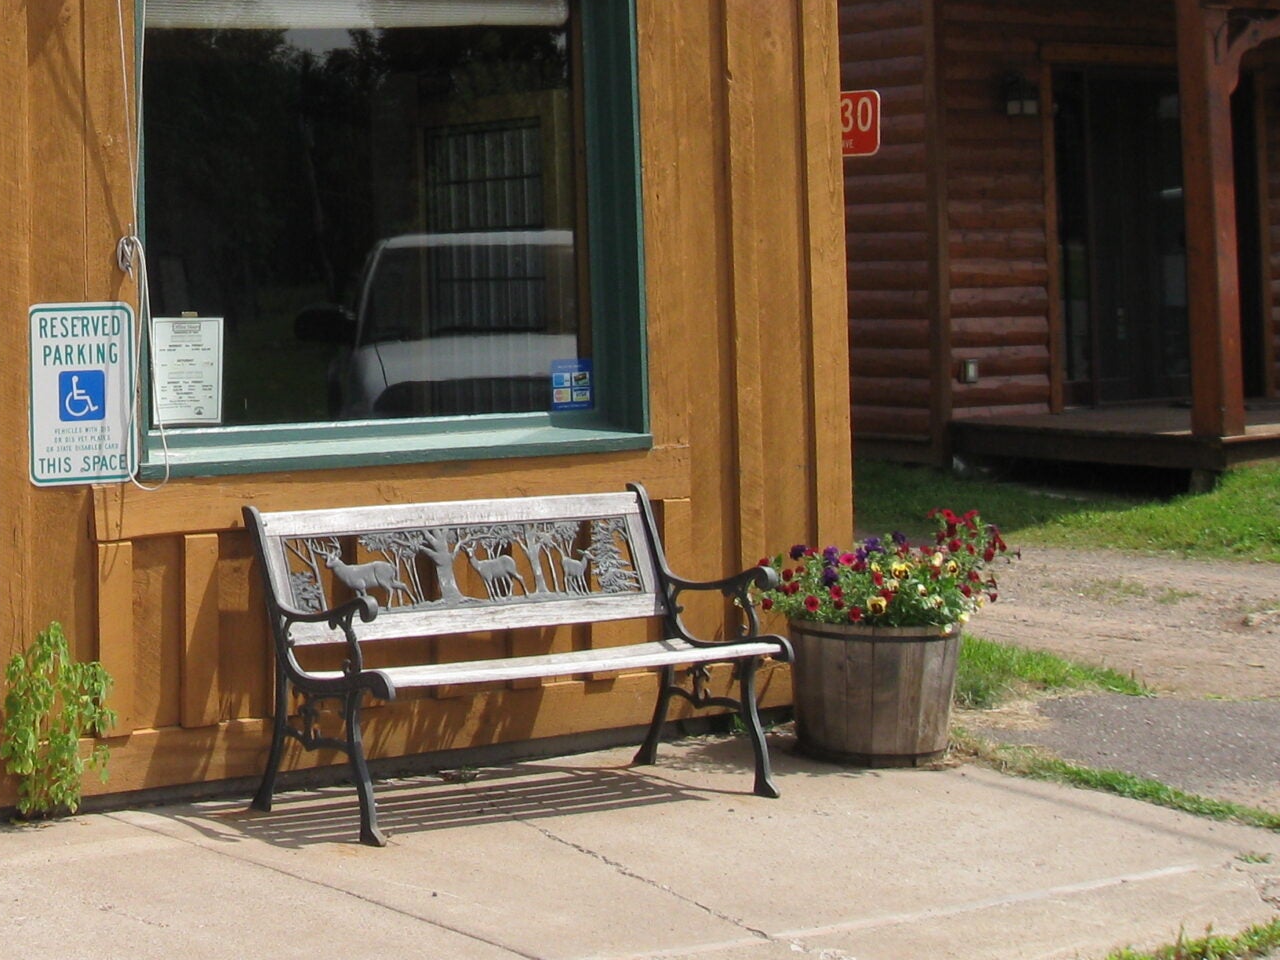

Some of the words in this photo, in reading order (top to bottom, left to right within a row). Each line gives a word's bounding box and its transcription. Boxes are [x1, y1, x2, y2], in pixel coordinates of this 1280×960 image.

[38, 315, 121, 339] RESERVED
[42, 342, 119, 367] PARKING
[54, 426, 82, 435] VEHICLES
[85, 426, 98, 434] WITH
[38, 455, 73, 475] THIS
[81, 453, 128, 473] SPACE
